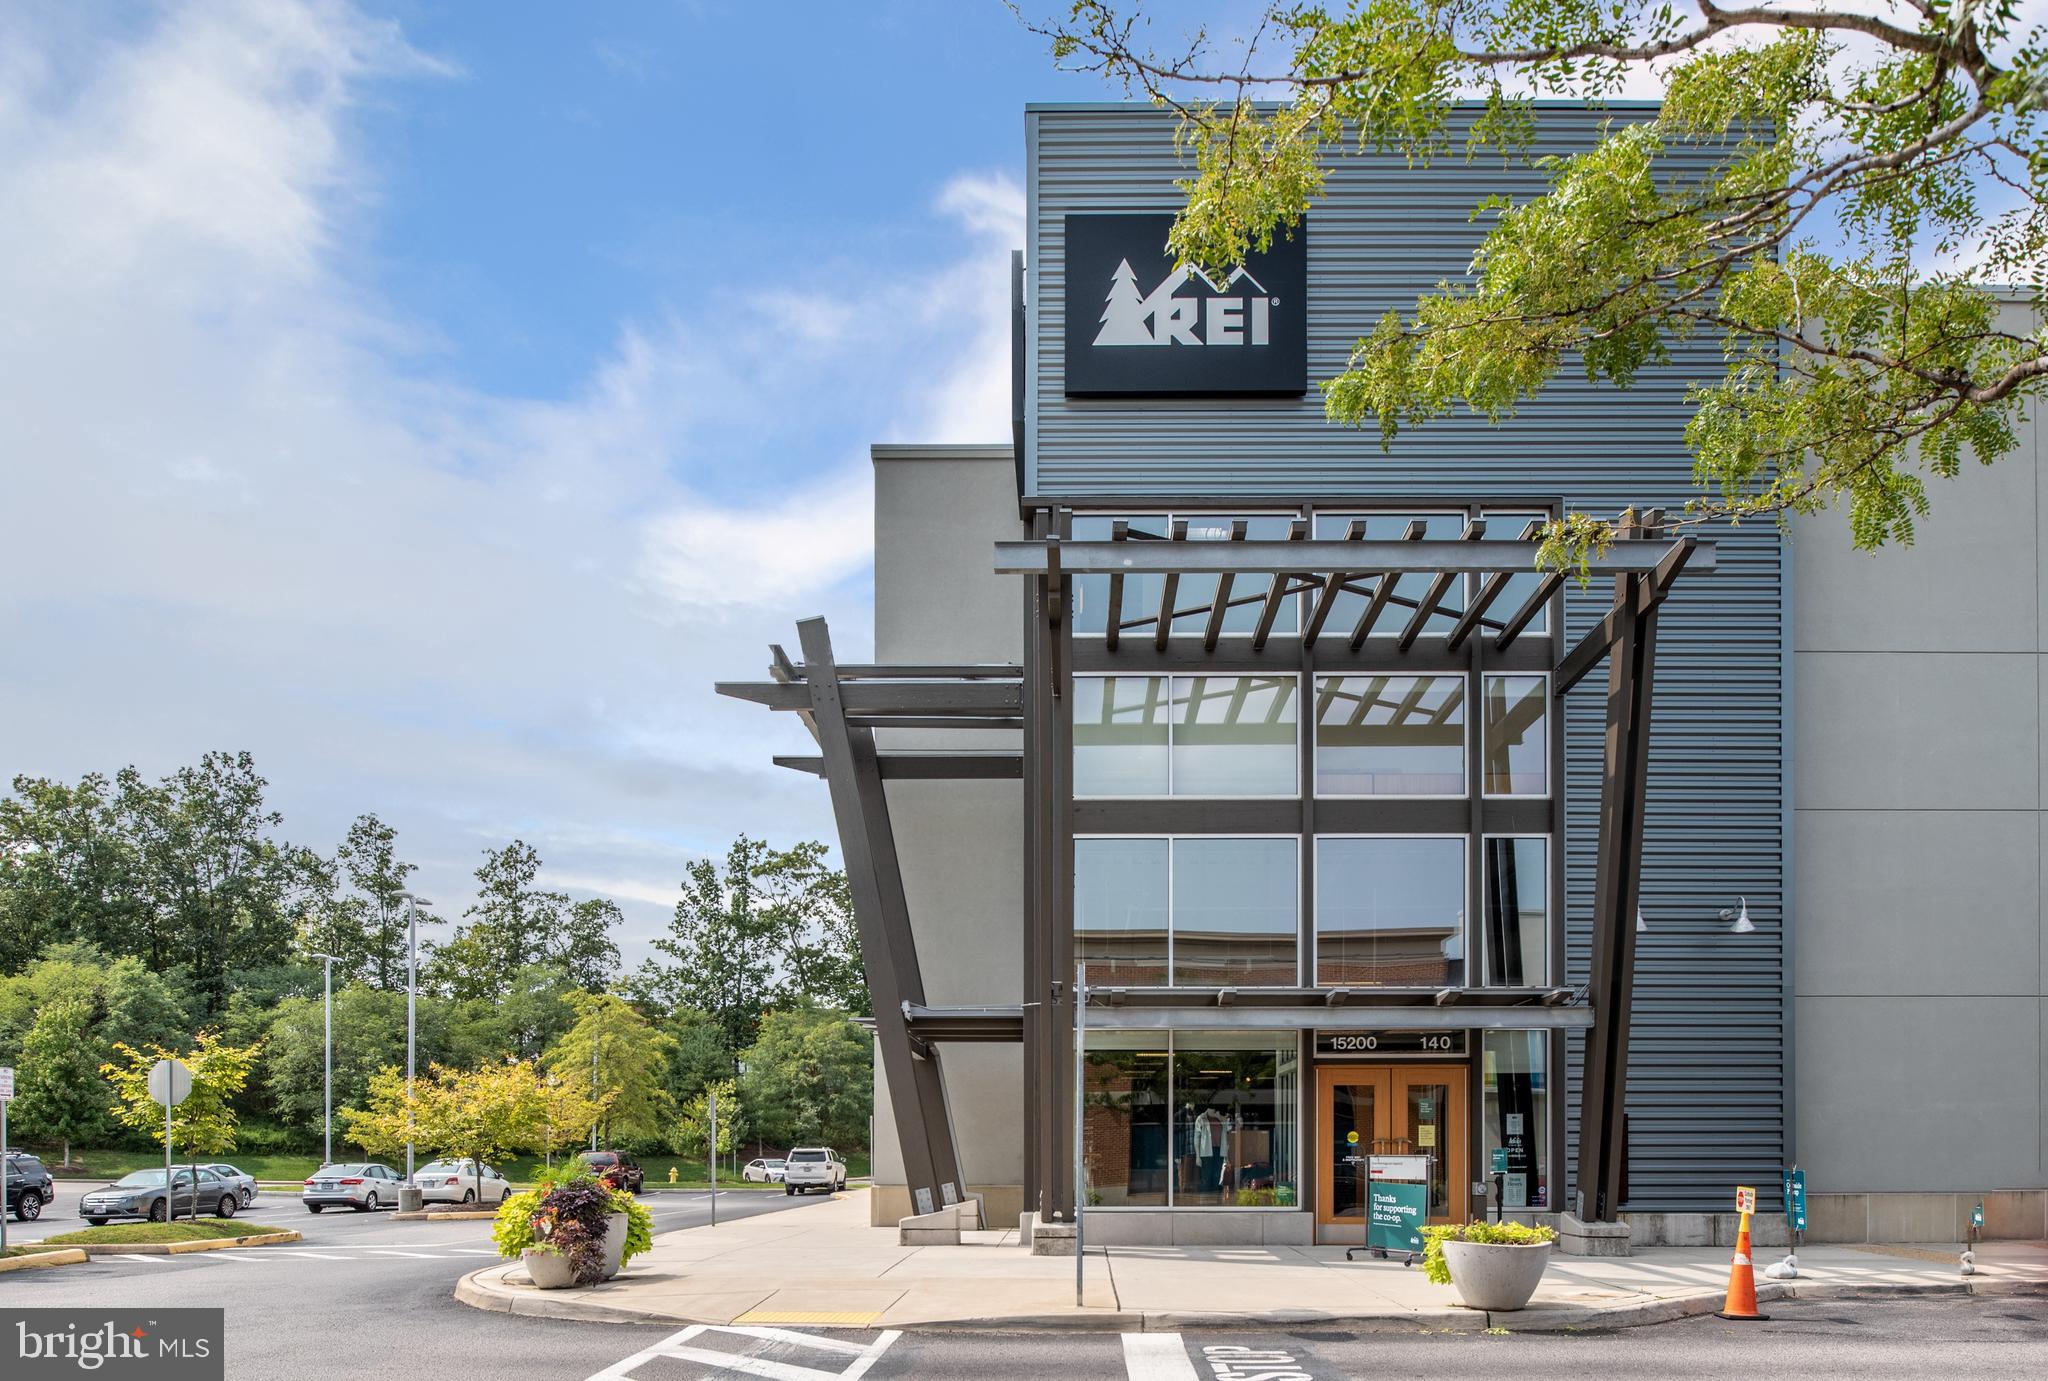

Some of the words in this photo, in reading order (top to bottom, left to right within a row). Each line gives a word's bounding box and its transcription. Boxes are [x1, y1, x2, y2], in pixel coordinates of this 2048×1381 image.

[1330, 1036, 1377, 1050] 15200
[1420, 1036, 1451, 1049] 140
[1373, 1193, 1397, 1204] Thanks
[1373, 1202, 1383, 1211] for
[1383, 1204, 1417, 1217] supporting
[1373, 1211, 1383, 1220] the
